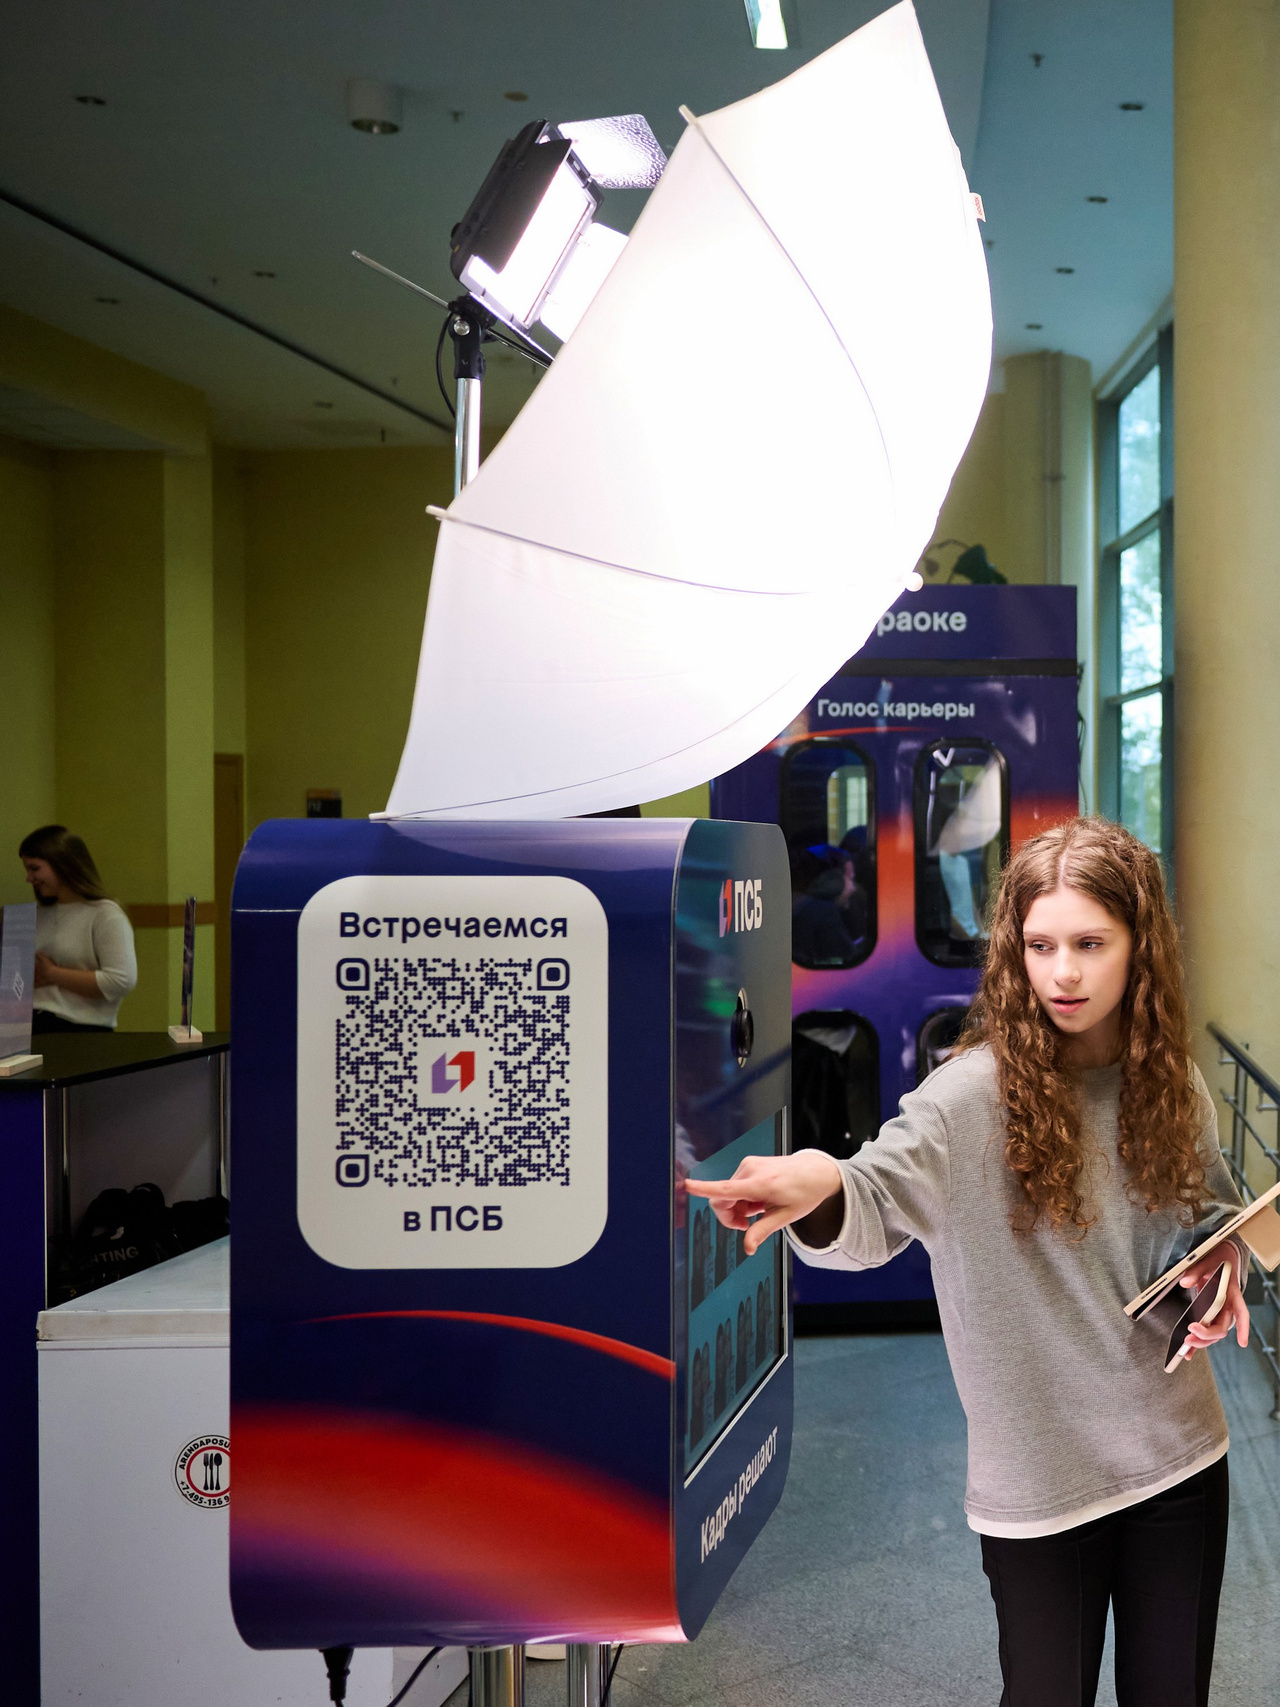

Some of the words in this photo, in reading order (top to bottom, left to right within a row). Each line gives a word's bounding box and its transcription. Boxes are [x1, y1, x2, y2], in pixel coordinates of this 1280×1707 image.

[817, 698, 879, 717] Голос
[883, 702, 975, 720] карьеры
[735, 878, 763, 933] ПСБ
[340, 911, 568, 943] Встречаемся
[404, 1211, 421, 1232] в
[430, 1205, 503, 1232] ПСБ
[178, 1438, 231, 1470] ARENDAPOSU
[700, 1482, 738, 1564] Кадры
[738, 1425, 778, 1515] решают
